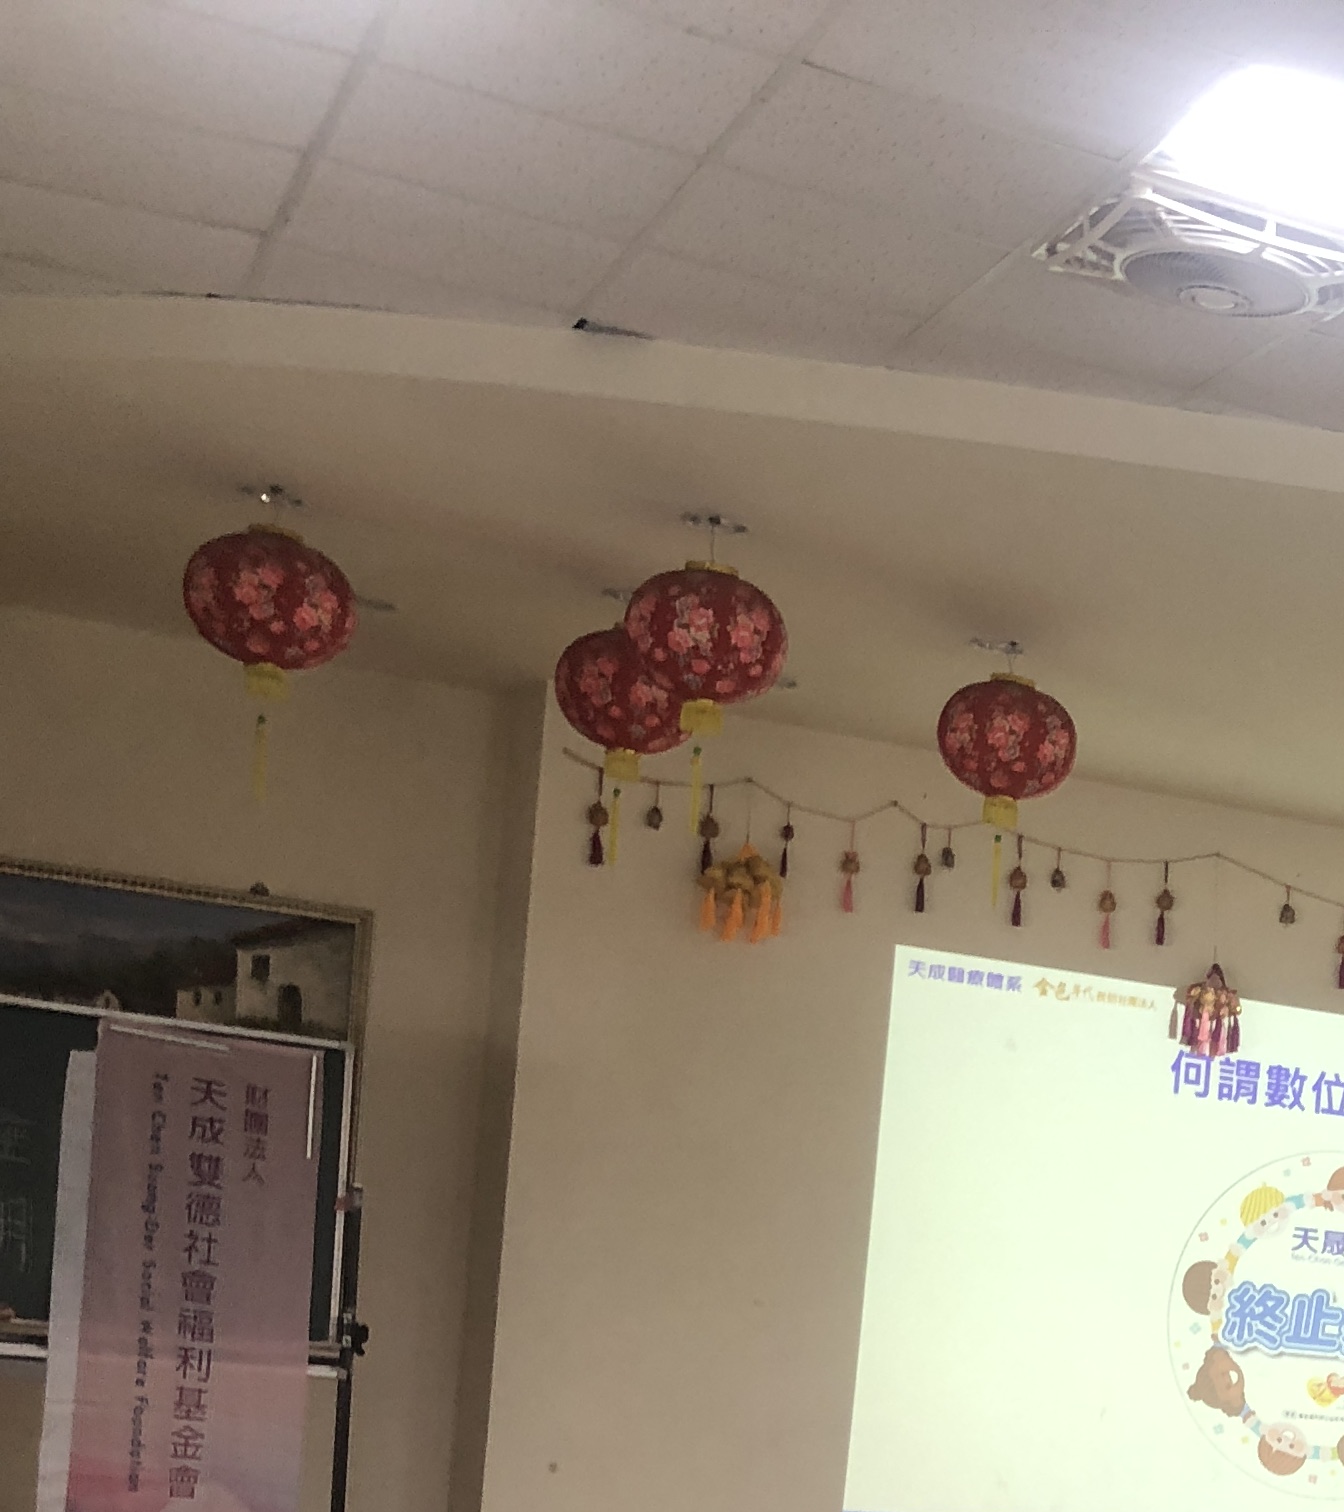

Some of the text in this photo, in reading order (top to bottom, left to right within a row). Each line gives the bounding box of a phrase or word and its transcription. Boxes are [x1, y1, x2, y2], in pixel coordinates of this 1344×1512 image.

[169, 1076, 227, 1499] 天成雙德社會福利基金會
